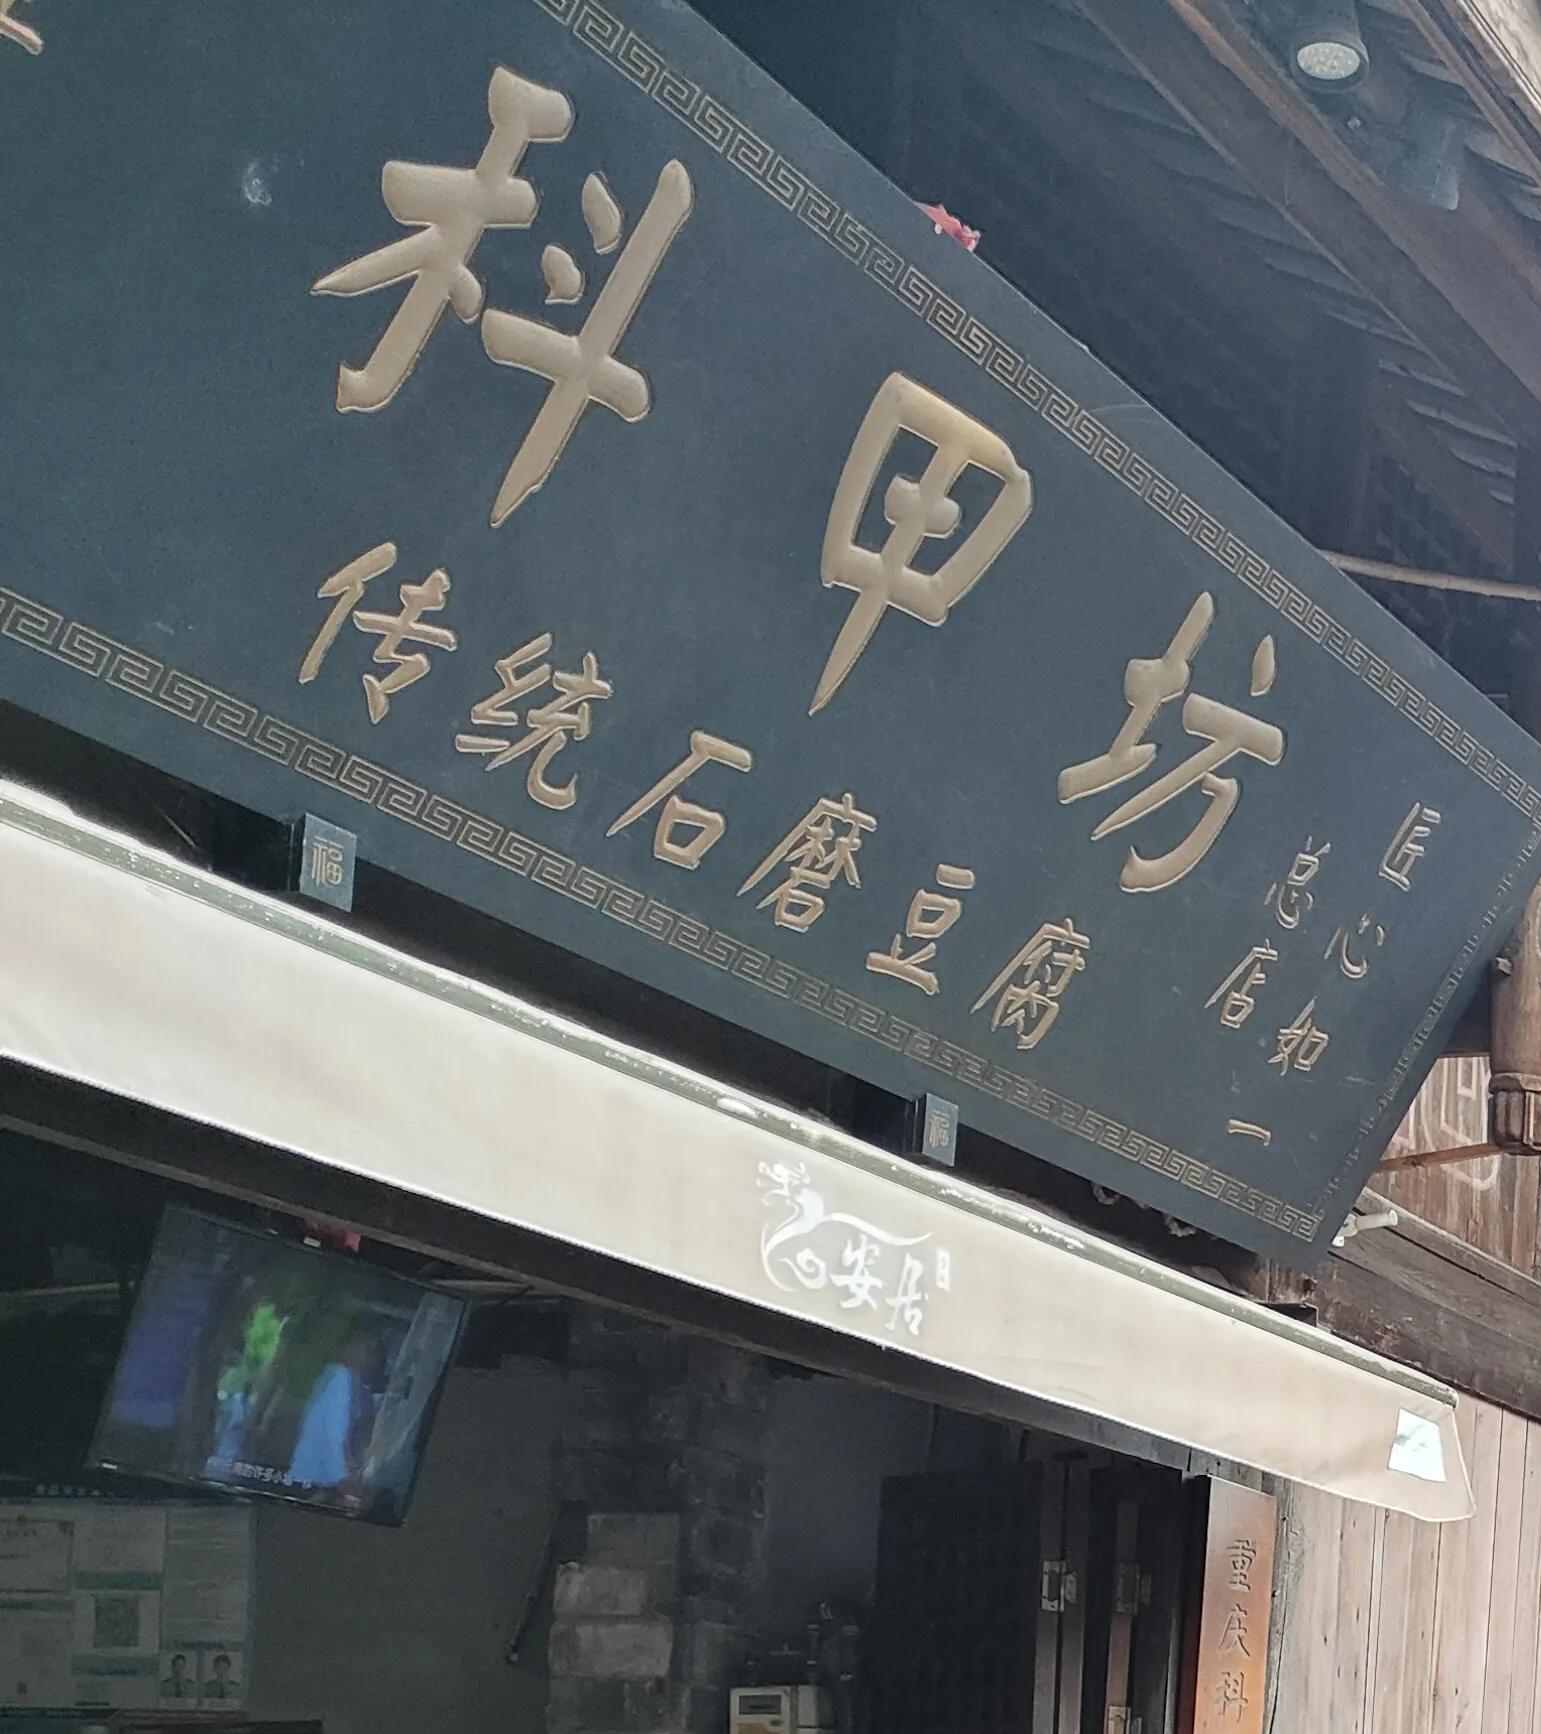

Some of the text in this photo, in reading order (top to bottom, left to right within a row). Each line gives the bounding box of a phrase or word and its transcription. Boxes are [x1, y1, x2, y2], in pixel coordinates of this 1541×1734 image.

[311, 66, 1285, 893] 科甲坊
[299, 542, 1092, 1050] 传统石磨豆腐
[1204, 836, 1331, 1028] 总店
[1228, 802, 1442, 1146] 匠心如一
